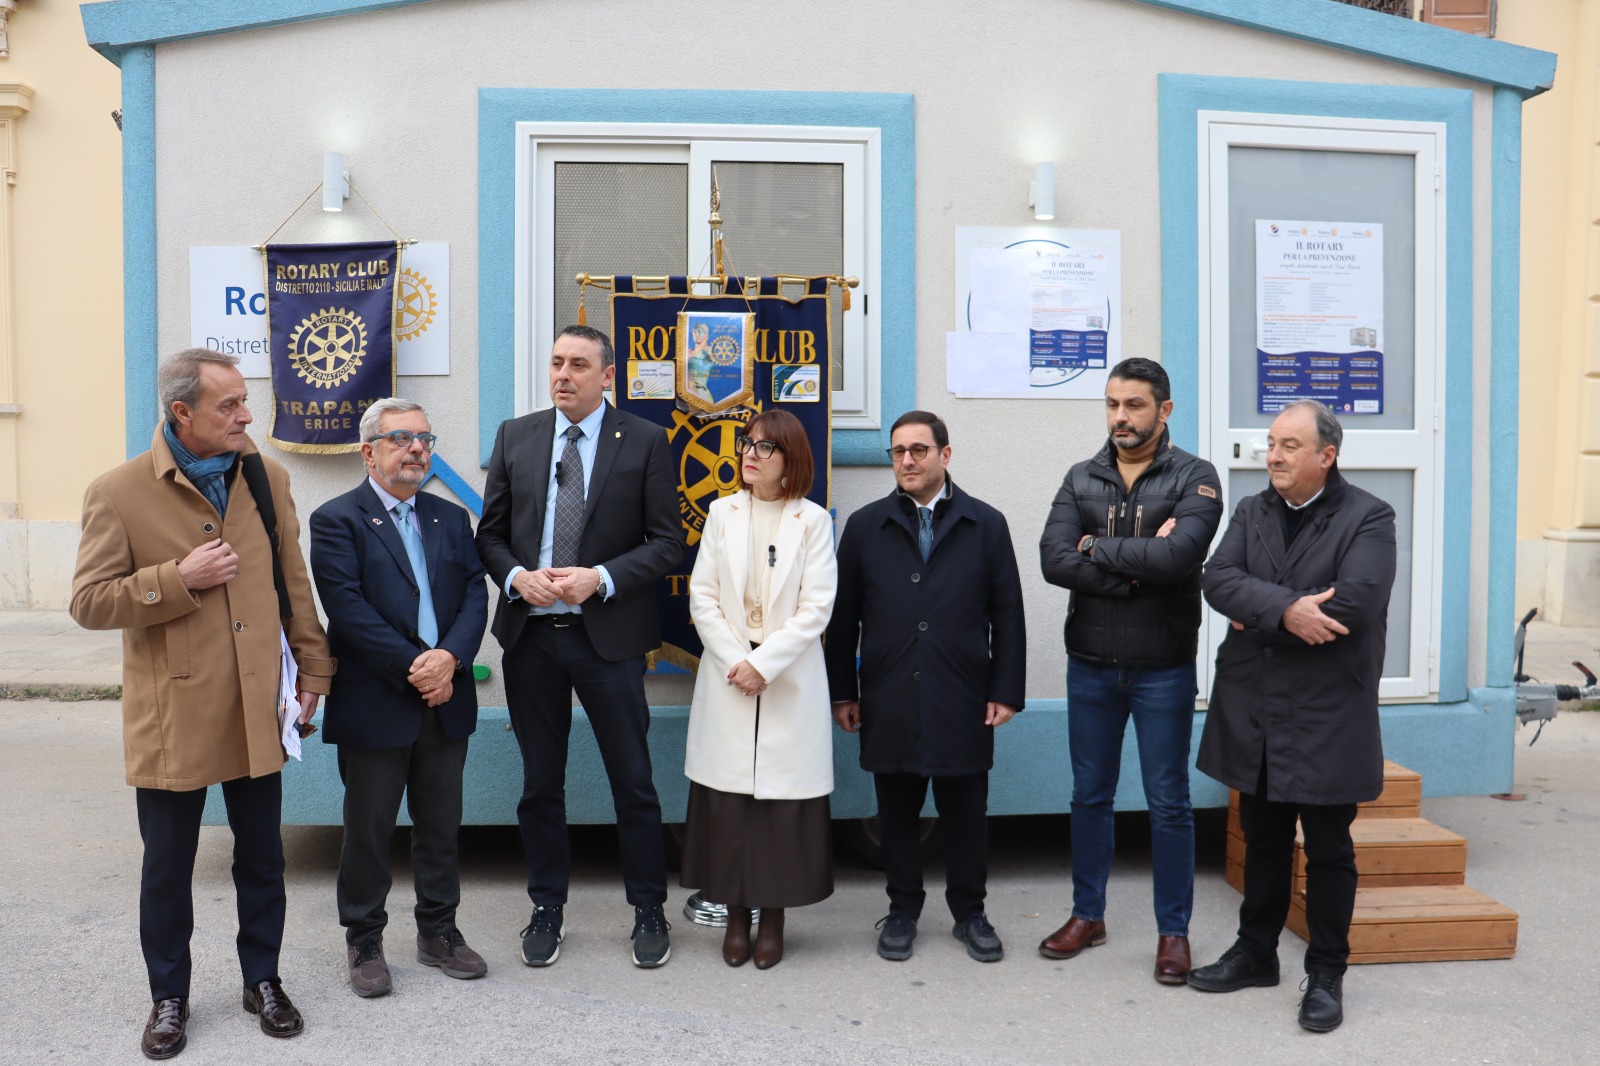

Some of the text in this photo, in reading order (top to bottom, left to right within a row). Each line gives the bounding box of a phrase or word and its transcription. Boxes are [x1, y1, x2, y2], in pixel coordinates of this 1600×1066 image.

[1306, 241, 1344, 251] ROTARY
[276, 260, 390, 280] ROTARY CLUB
[275, 281, 316, 295] DISTRETTO
[315, 281, 331, 293] 2110
[335, 280, 360, 293] SICILIA
[360, 280, 366, 291] E
[315, 315, 350, 327] ROTARY
[206, 336, 270, 354] Distret
[300, 357, 357, 381] INTERNATIONAL
[281, 397, 384, 416] TRAPAN
[304, 417, 352, 430] ERICE
